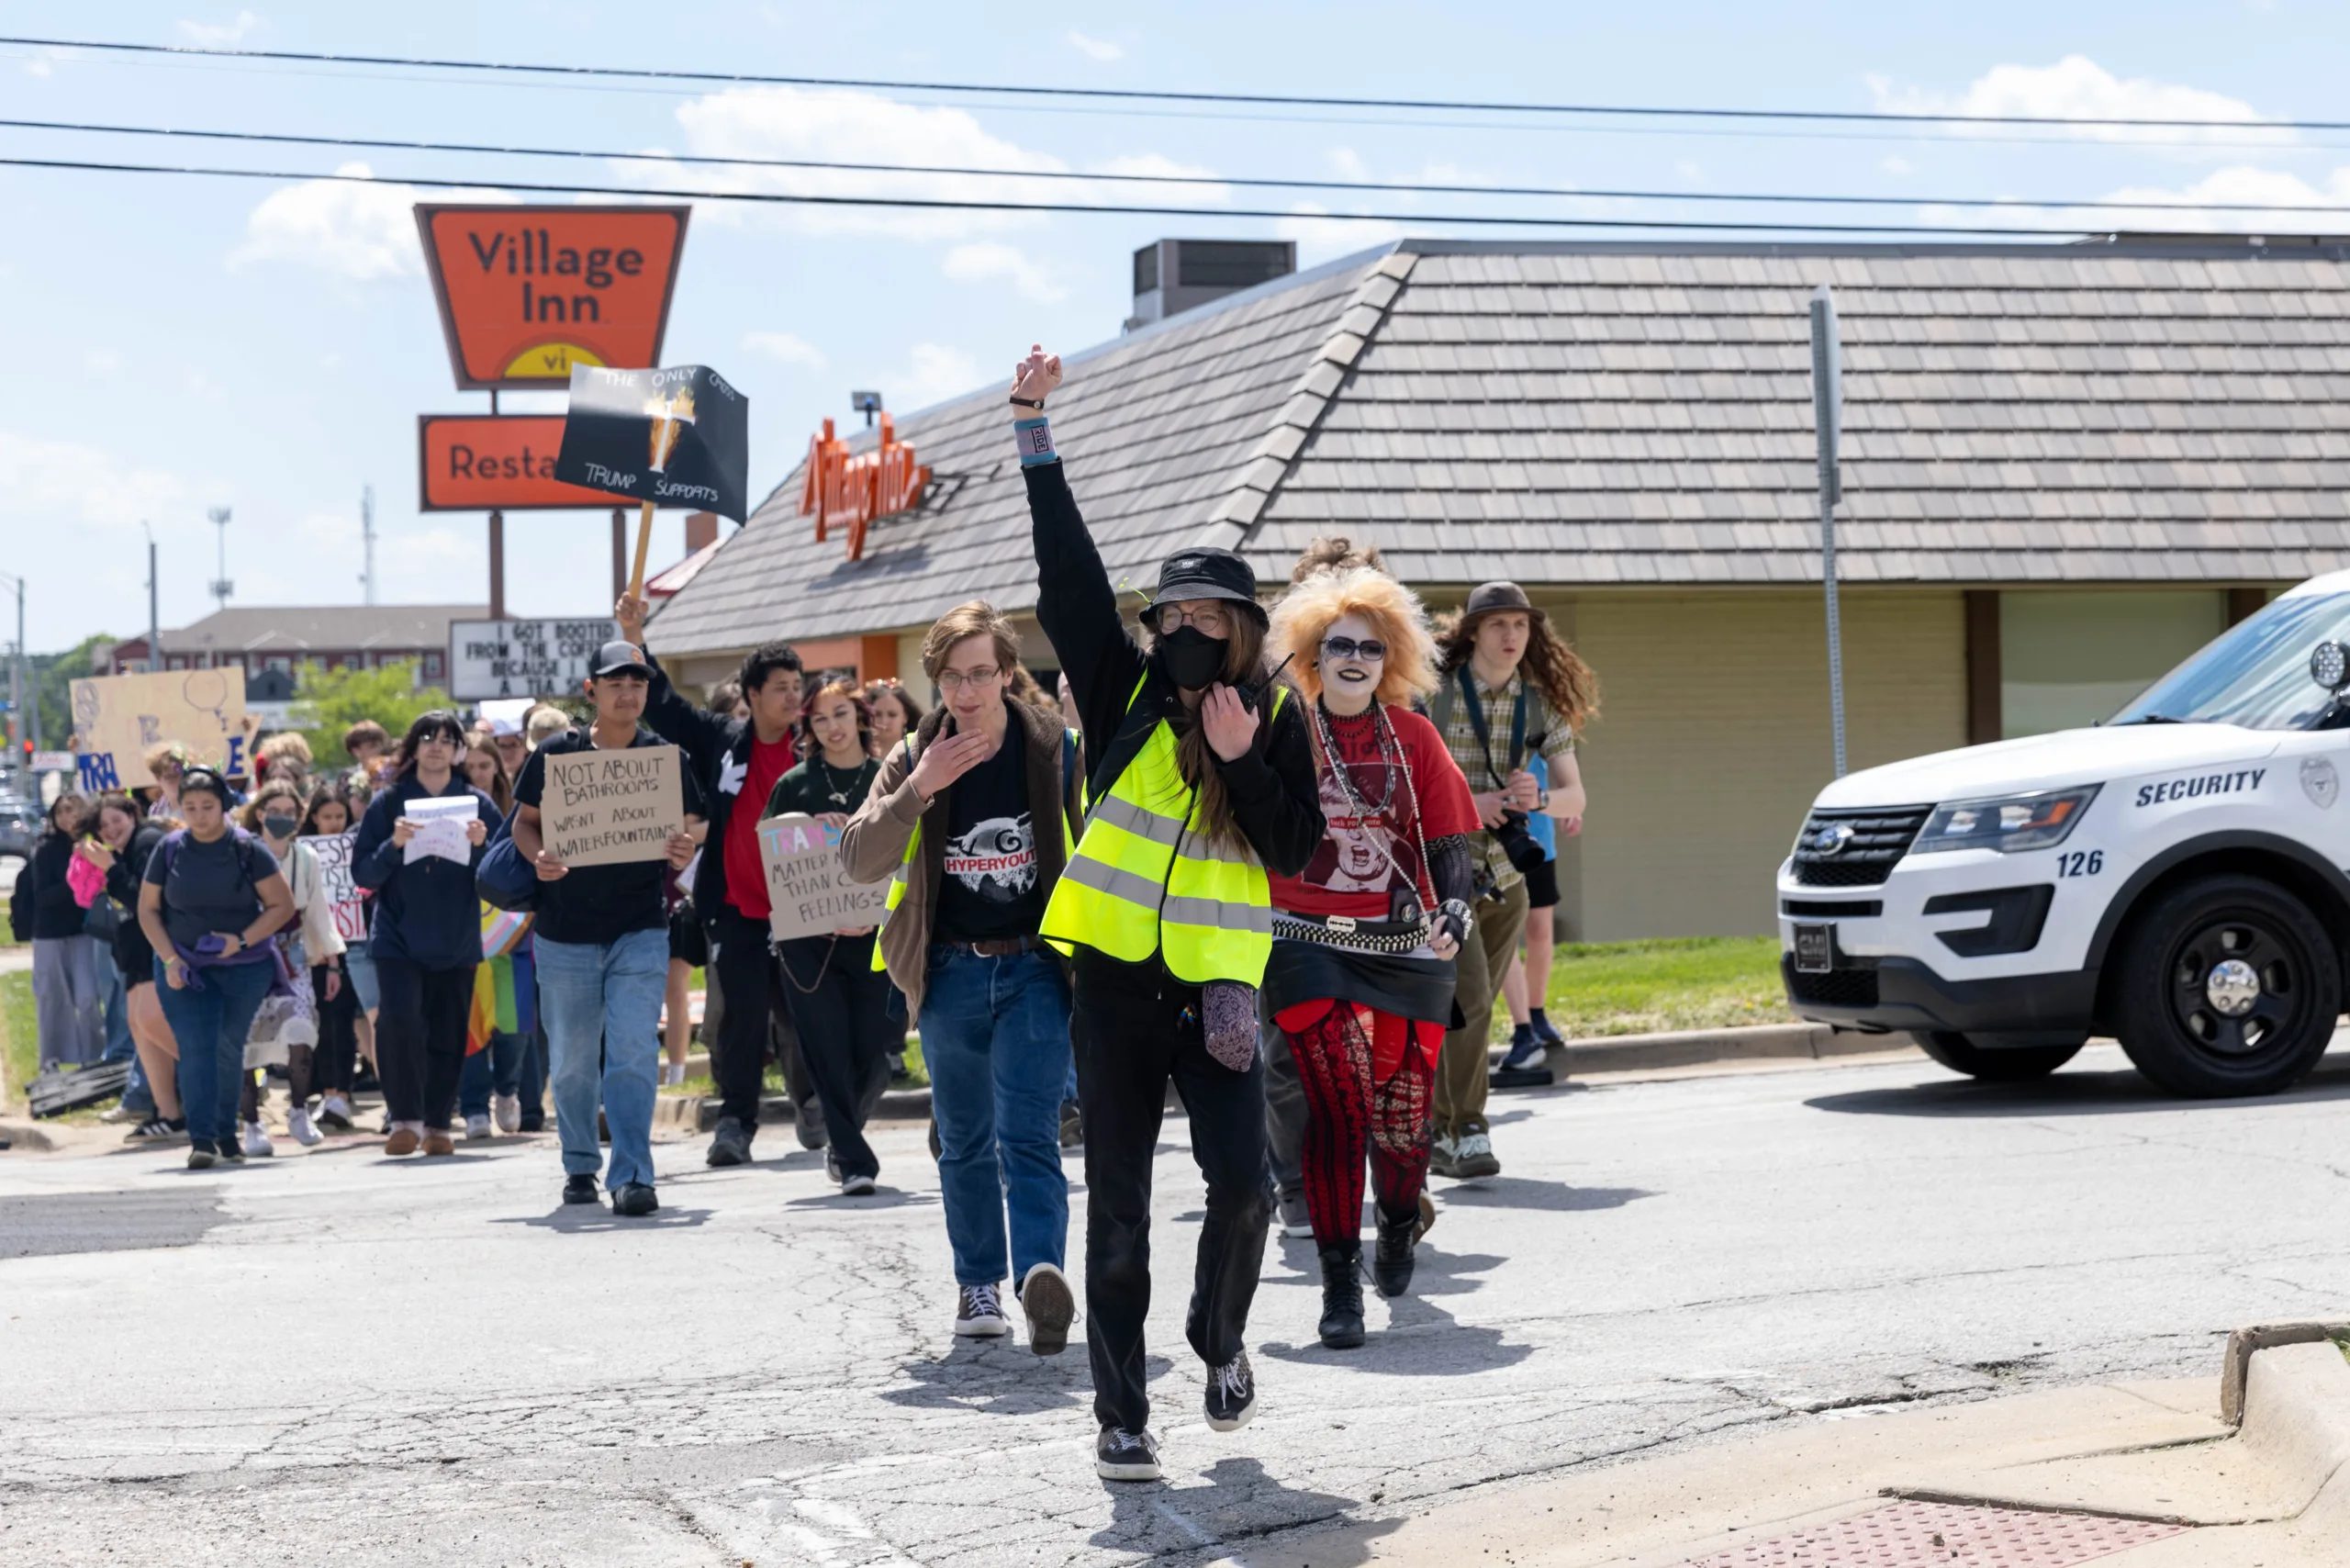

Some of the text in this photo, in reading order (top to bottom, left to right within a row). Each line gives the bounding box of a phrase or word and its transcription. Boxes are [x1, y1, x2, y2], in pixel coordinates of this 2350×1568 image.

[468, 228, 644, 289] Village
[522, 282, 599, 322] Inn
[543, 347, 566, 371] vi
[603, 372, 639, 387] THE
[651, 367, 698, 387] ONLY
[585, 461, 719, 502] TRUMP SUPPORTS
[512, 623, 543, 640] GOT
[555, 623, 615, 640] BOOTED
[465, 643, 509, 659] FROM
[521, 642, 546, 658] THE
[491, 660, 559, 678] BECAUSE
[499, 679, 511, 697] A
[527, 678, 556, 697] TEA
[553, 756, 665, 788] NOT ABOUT
[563, 778, 659, 807] BATHROOMS
[2134, 767, 2267, 808] SECURITY
[553, 806, 658, 834] WASNT ABOUT
[763, 822, 841, 856] TRANS
[773, 854, 828, 884] MATTER
[2056, 850, 2105, 879] 126
[783, 873, 830, 899] THAN
[798, 890, 885, 923] FEELINGS
